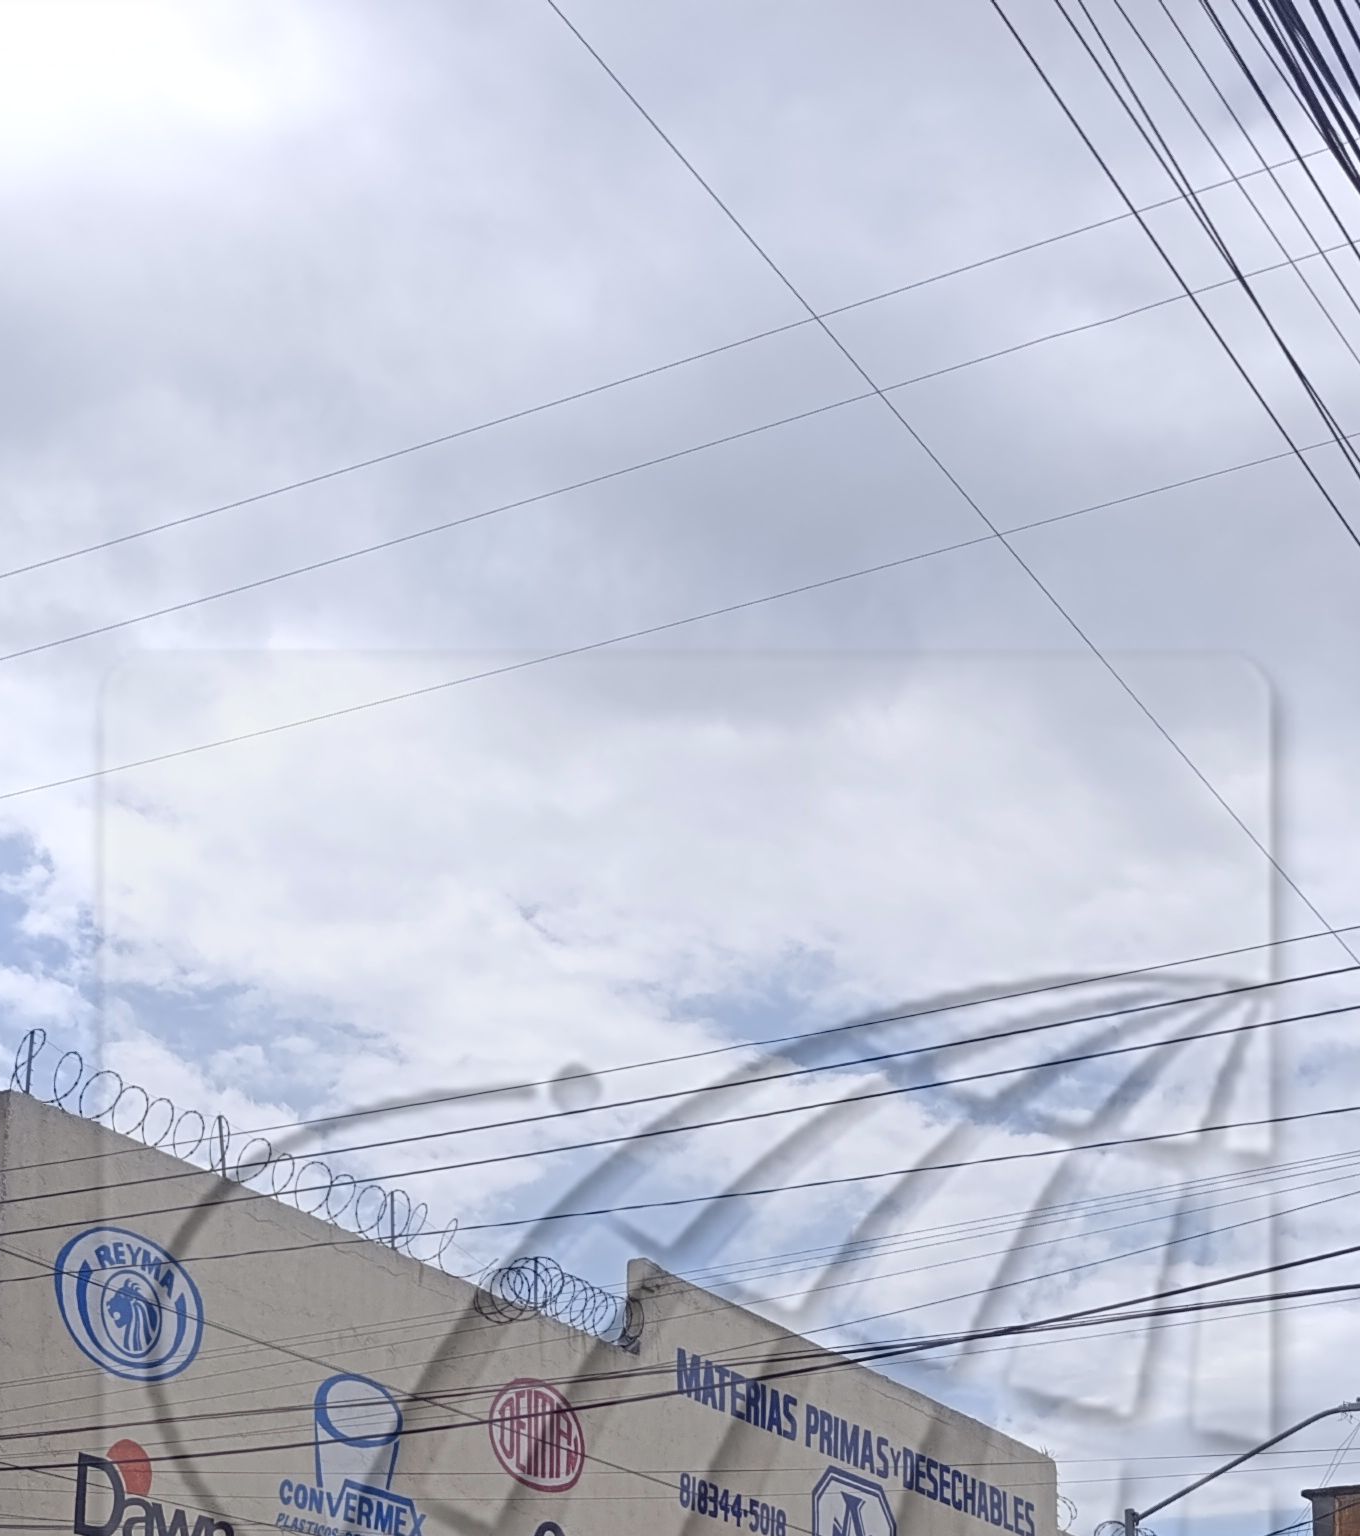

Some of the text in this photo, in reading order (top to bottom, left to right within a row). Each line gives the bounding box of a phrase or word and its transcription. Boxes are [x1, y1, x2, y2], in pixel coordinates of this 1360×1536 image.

[95, 1241, 176, 1290] REYMA
[676, 1347, 798, 1441] MATERIAS
[805, 1405, 889, 1479] PRIMAS
[890, 1447, 902, 1477] Y
